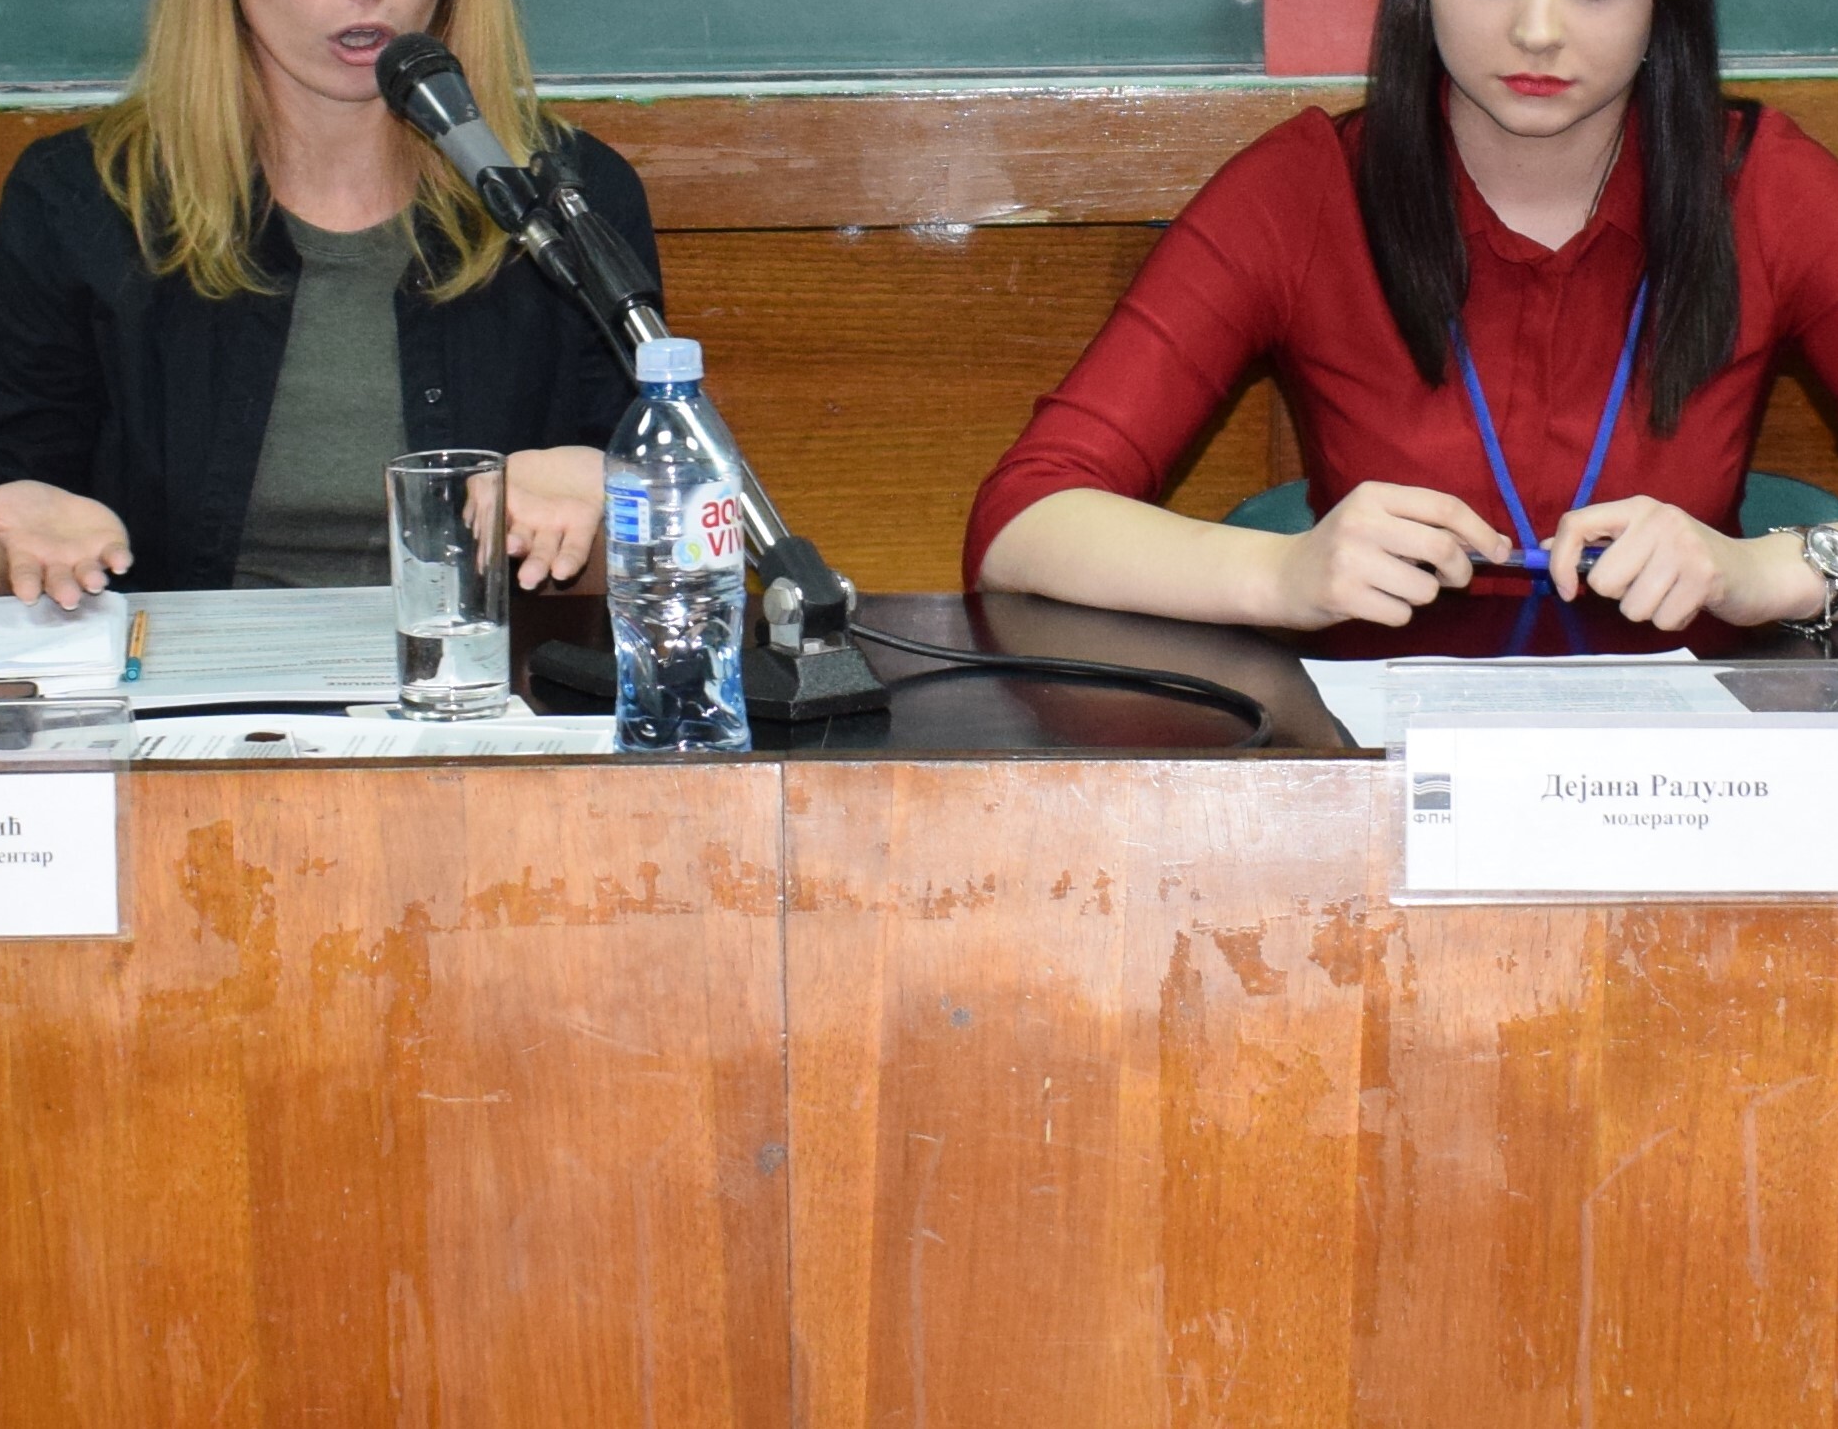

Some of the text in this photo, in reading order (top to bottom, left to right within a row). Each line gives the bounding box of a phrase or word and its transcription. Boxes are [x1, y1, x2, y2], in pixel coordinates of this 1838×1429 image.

[1542, 775, 1768, 803] Дејана Радулов
[1413, 813, 1451, 824] ФПН
[1603, 814, 1708, 830] модератор
